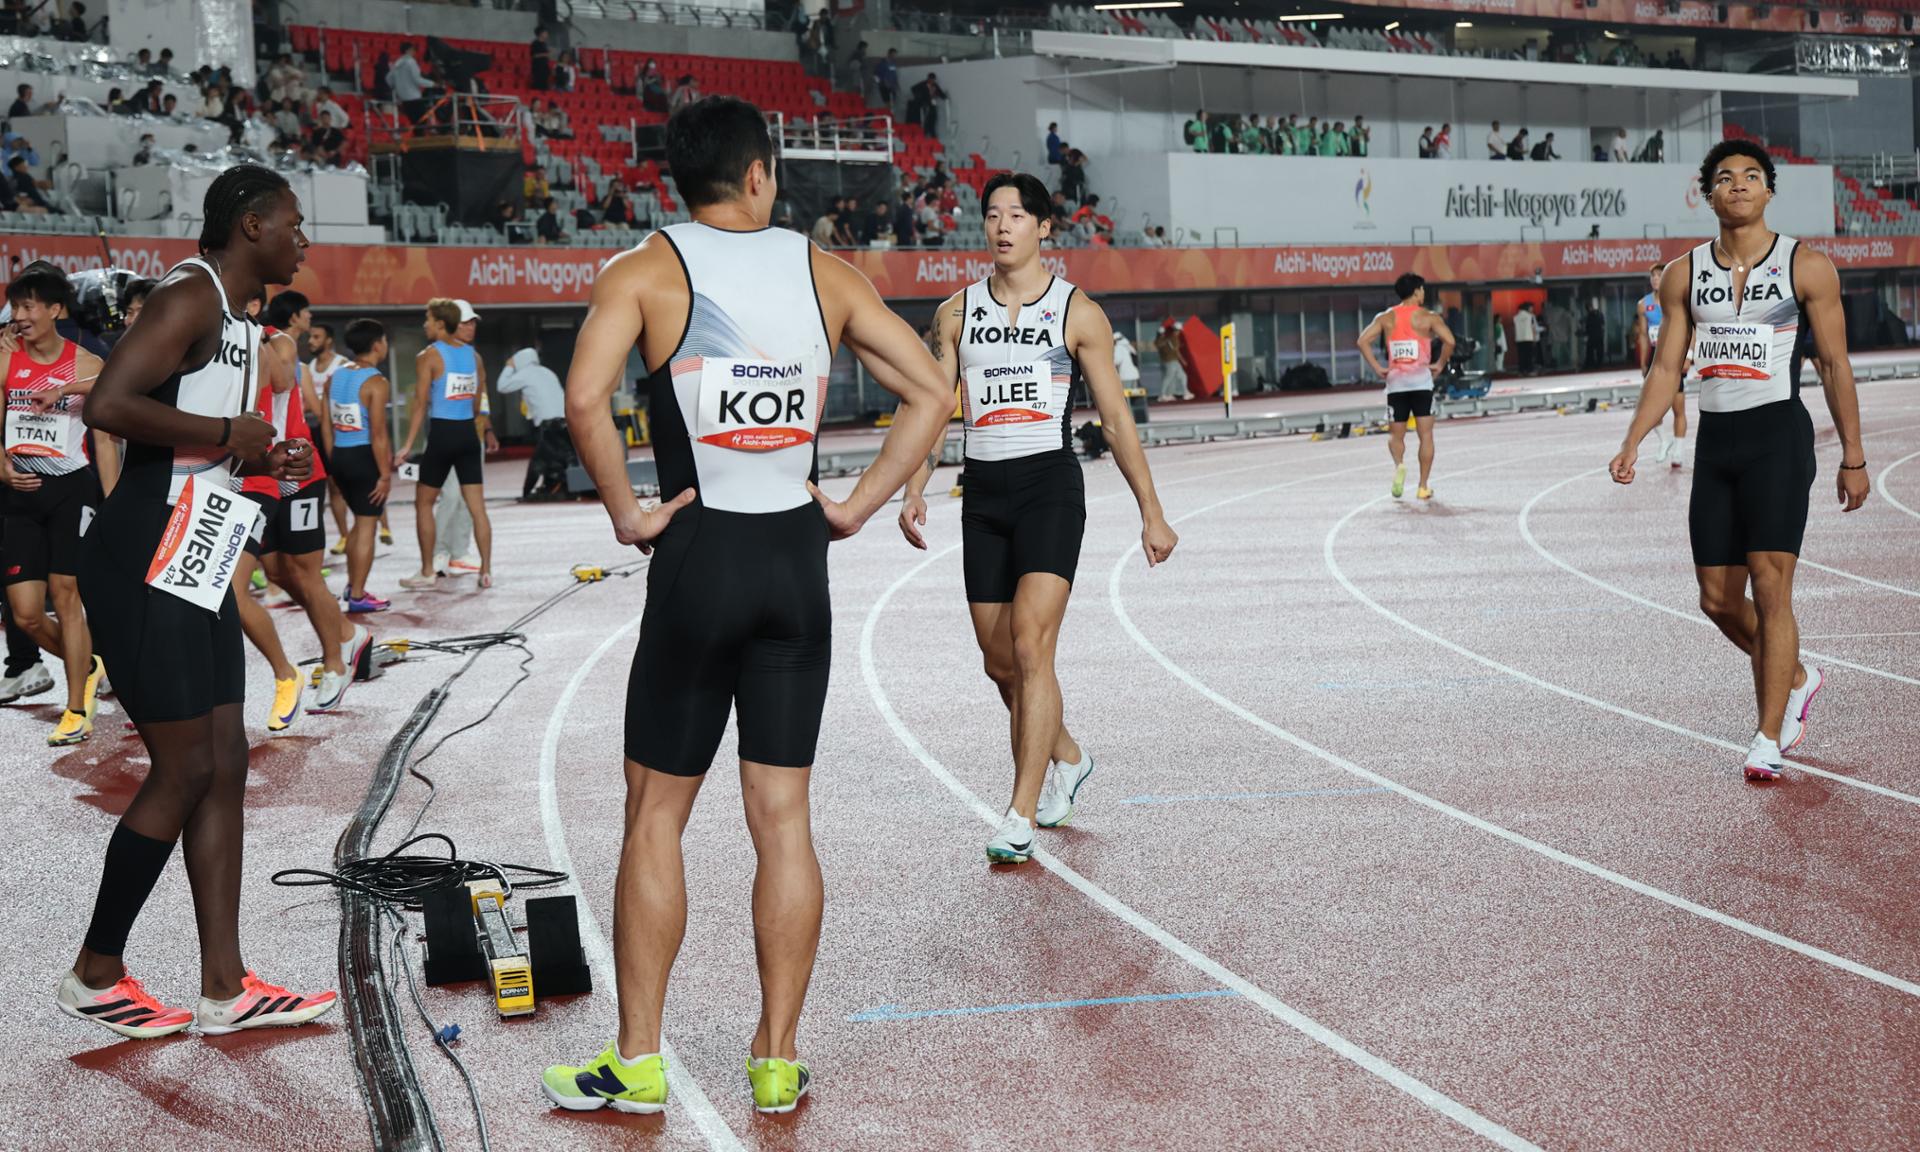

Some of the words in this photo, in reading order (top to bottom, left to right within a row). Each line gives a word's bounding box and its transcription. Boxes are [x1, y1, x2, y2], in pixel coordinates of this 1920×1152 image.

[1445, 185, 1577, 227] Aichi-Nagoya
[1580, 188, 1626, 217] 2026
[1562, 245, 1633, 268] Aichi-Nagoya
[1635, 243, 1661, 262] 2026
[1871, 241, 1894, 257] 2026
[469, 255, 593, 293] Aichi-Nagoya
[1274, 251, 1360, 278] Aichi-Nagoya
[1363, 251, 1394, 271] 2026
[969, 326, 1053, 348] KOREA
[1709, 326, 1756, 335] BORNAN
[1698, 341, 1767, 361] NWAMADI
[730, 361, 802, 379] BORNAN
[983, 365, 1033, 378] BORNAN
[980, 382, 1038, 405] J.LEE
[719, 388, 805, 425] KOR
[15, 427, 57, 442] T.TAN
[404, 466, 413, 477] 4
[301, 503, 311, 526] 7
[173, 492, 232, 588] BIWESA
[211, 522, 246, 589] BORNAN
[163, 564, 176, 585] 474
